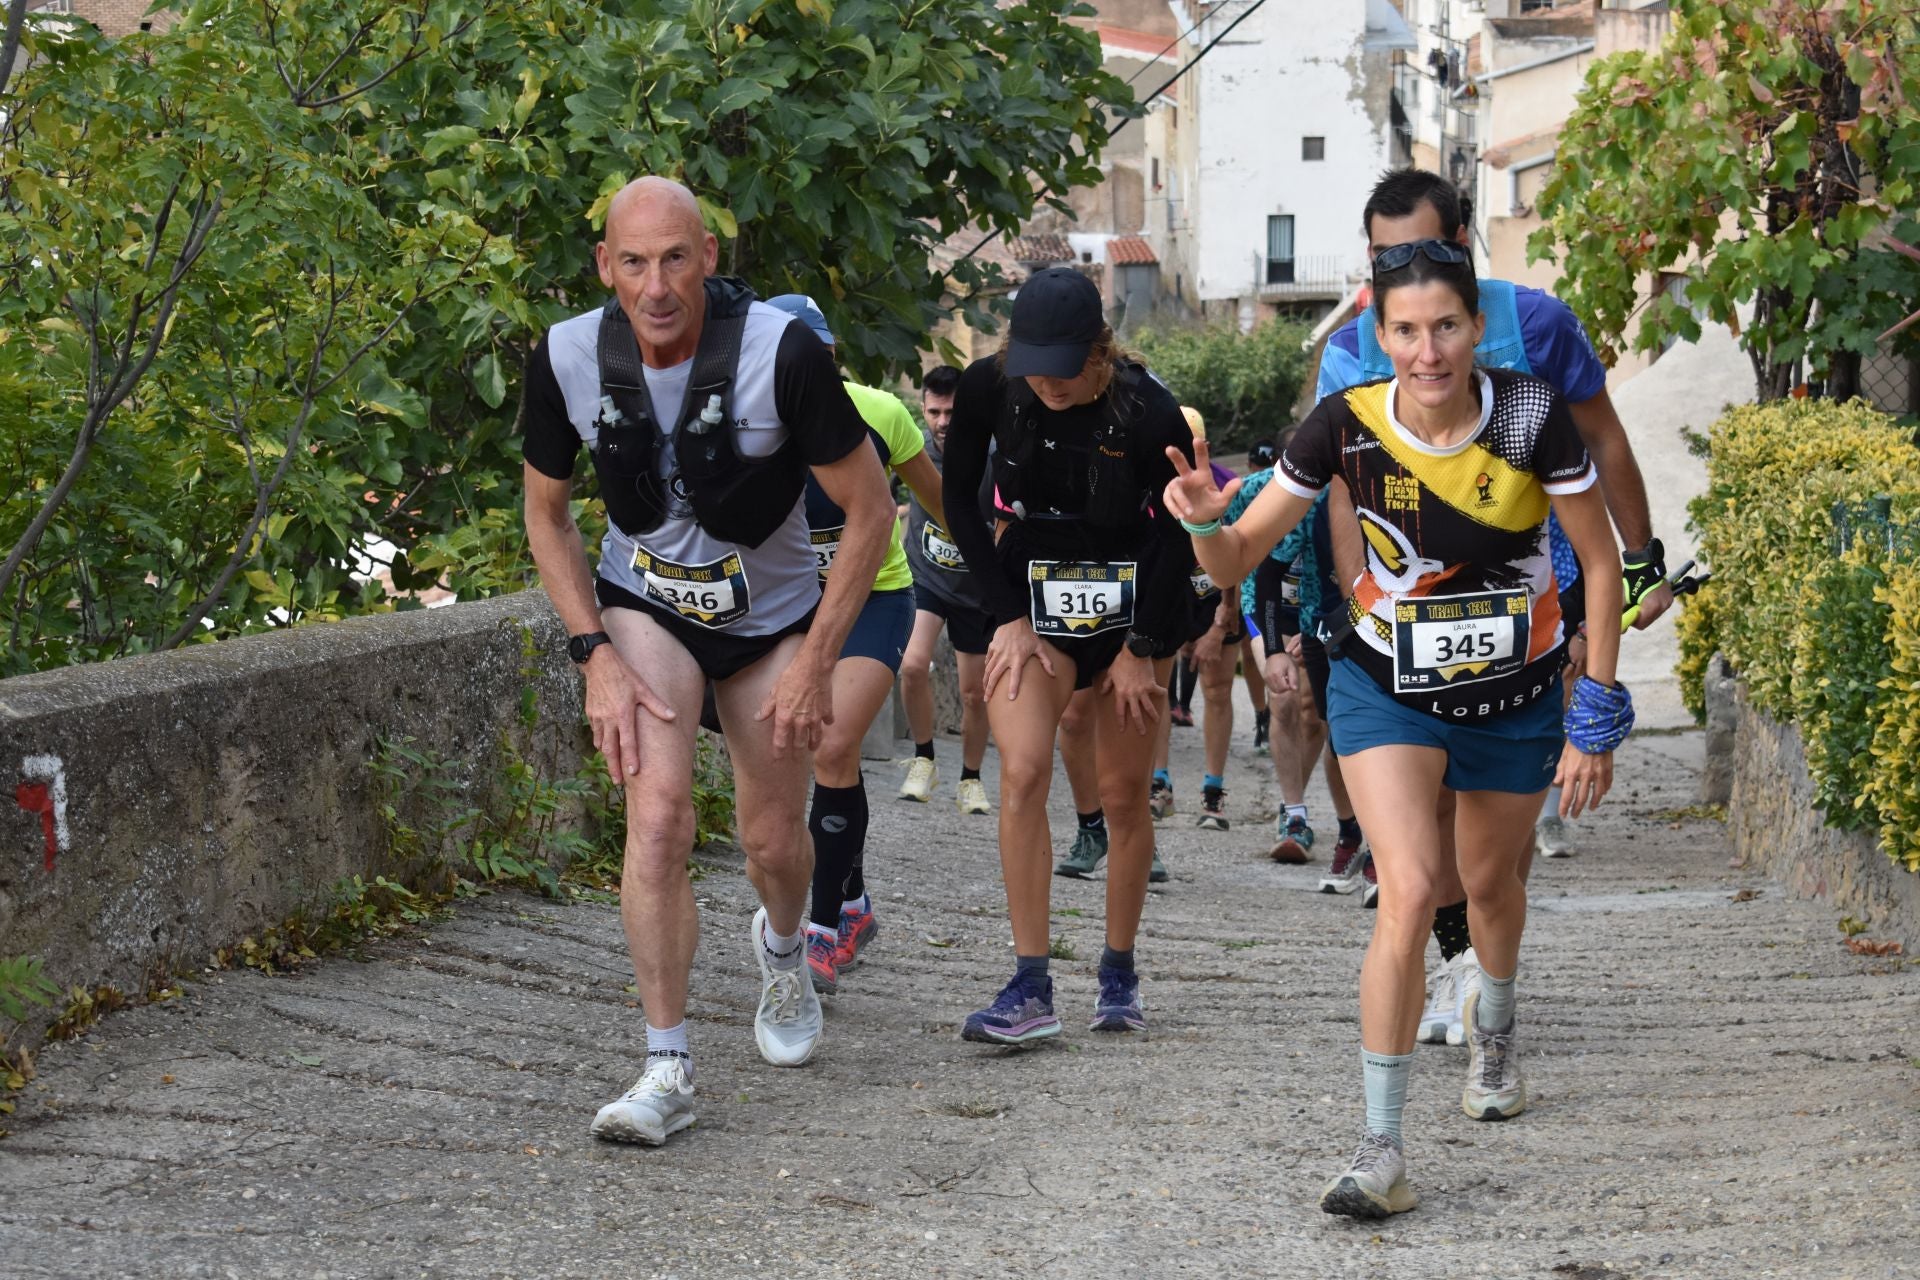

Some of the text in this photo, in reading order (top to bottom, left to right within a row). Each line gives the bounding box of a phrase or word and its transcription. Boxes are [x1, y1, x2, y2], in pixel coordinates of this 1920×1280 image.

[935, 544, 960, 560] 302
[656, 562, 712, 581] TRAIL 13K
[1056, 567, 1083, 579] TRAIL
[1087, 567, 1107, 580] 13K
[663, 587, 719, 610] 346
[1060, 592, 1107, 615] 316
[1427, 603, 1463, 619] TRAIL
[1466, 600, 1493, 616] 13K
[1453, 623, 1477, 631] LAURA
[1435, 632, 1496, 662] 345
